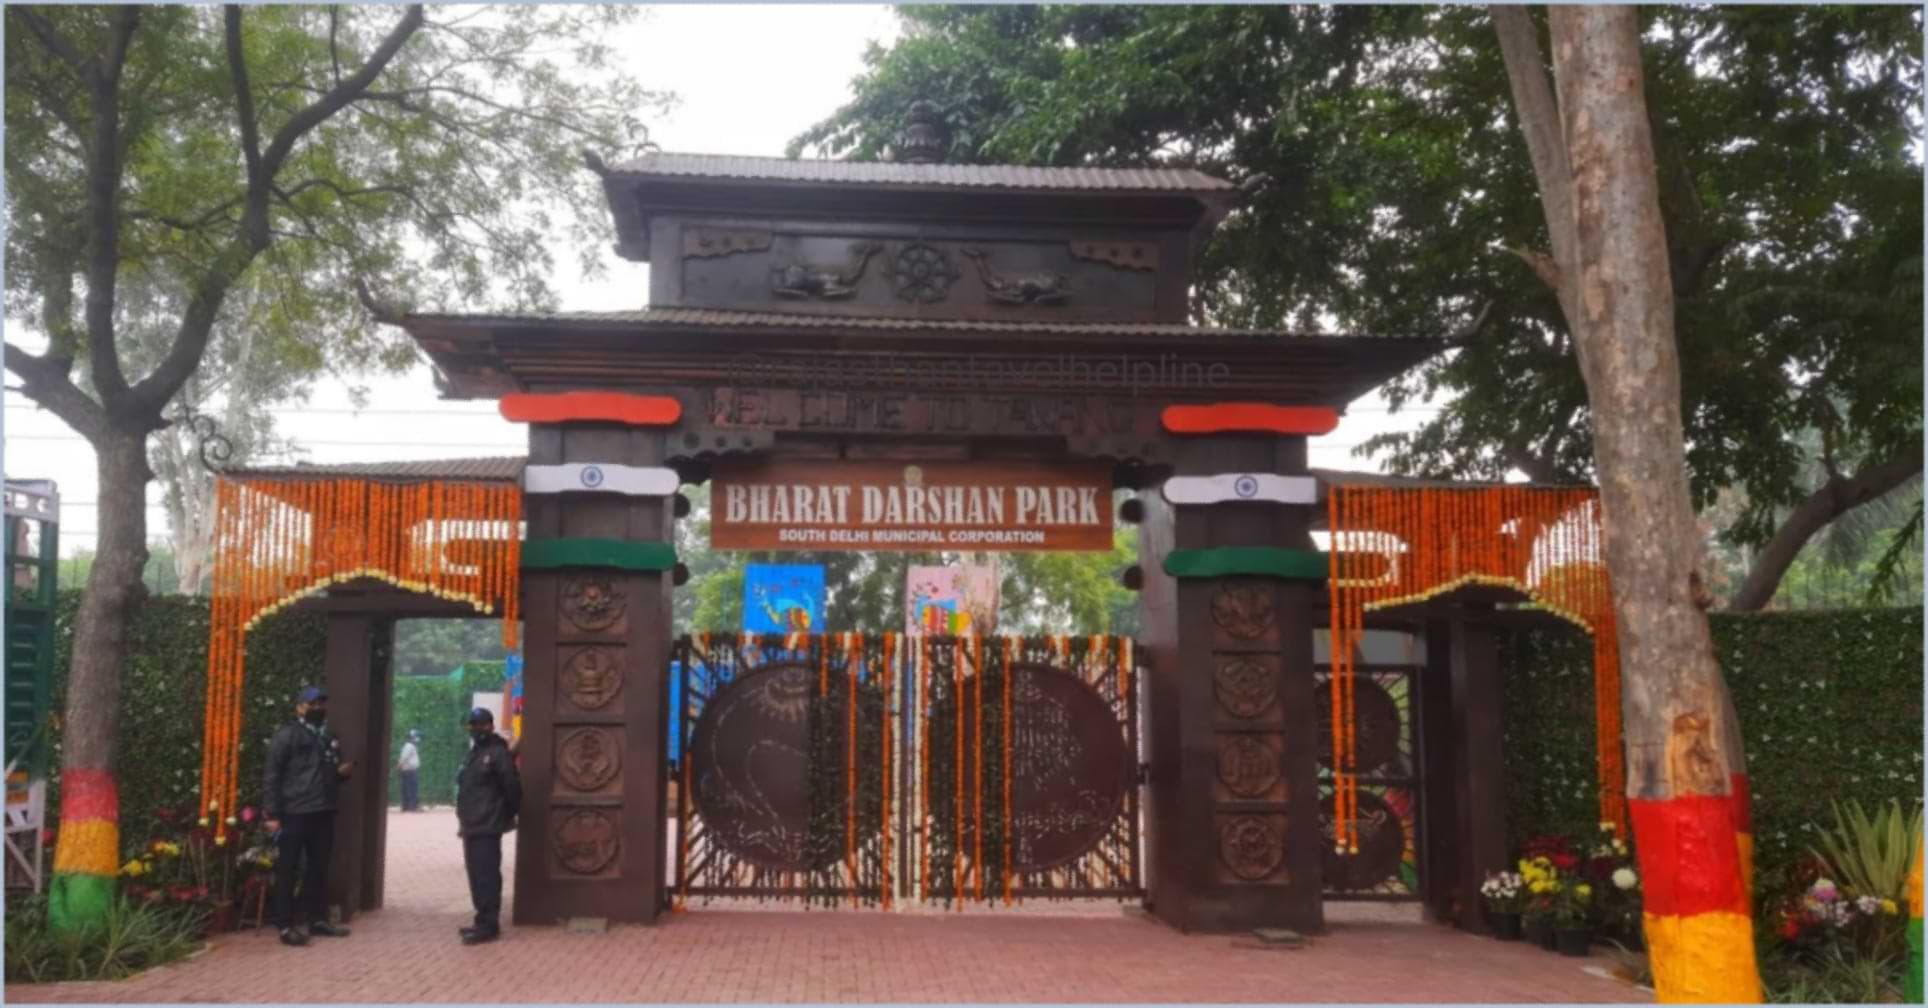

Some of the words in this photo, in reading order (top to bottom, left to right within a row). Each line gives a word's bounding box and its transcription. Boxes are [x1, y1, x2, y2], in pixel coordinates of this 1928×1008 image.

[725, 485, 852, 523] BHARAT
[862, 485, 1006, 525] DARSHAN
[1015, 485, 1101, 525] PARK
[778, 529, 826, 543] SOUTH
[830, 530, 869, 543] DELHI
[872, 530, 945, 544] MUNICIPAL
[948, 531, 1045, 544] CORPORATION
